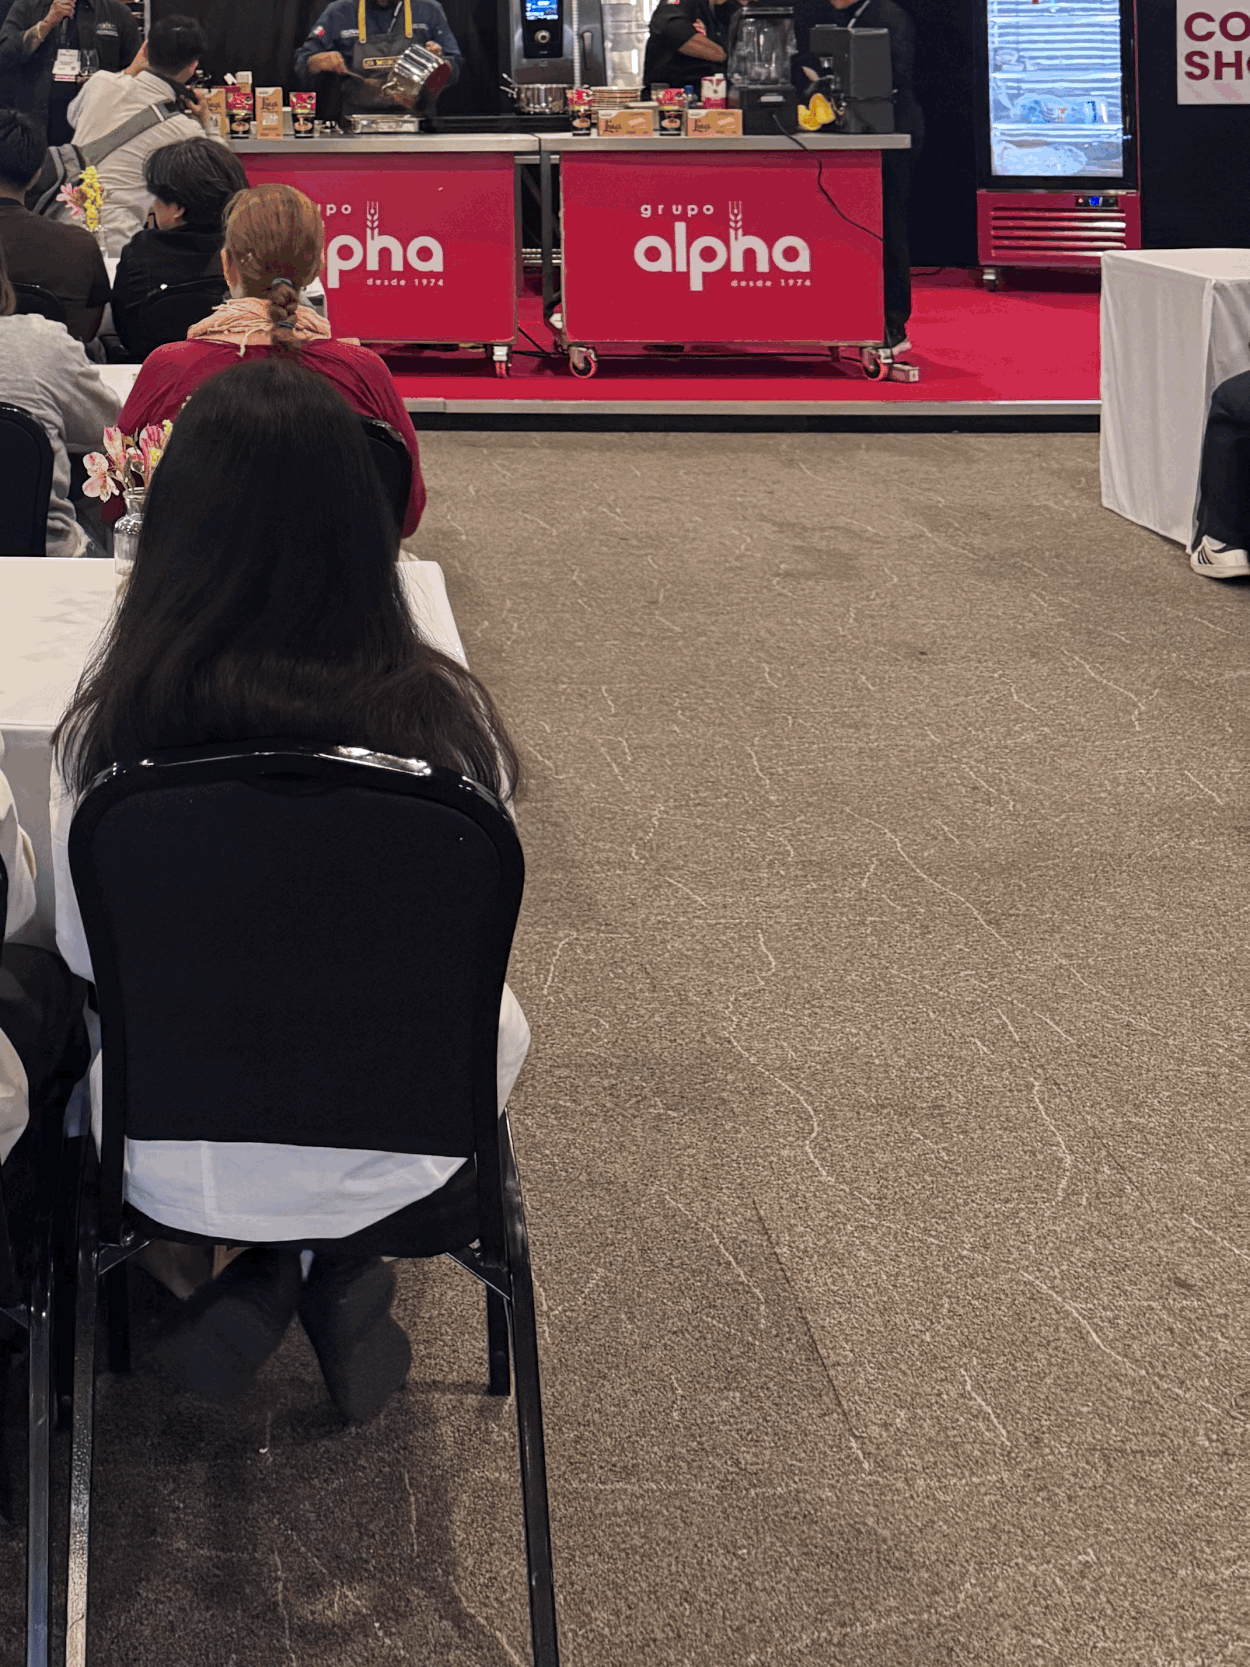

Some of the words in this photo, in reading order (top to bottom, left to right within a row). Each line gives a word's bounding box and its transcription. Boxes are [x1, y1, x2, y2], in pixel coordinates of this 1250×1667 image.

[1184, 50, 1250, 81] SH
[640, 204, 714, 218] grupo
[326, 201, 444, 289] pha
[634, 201, 811, 291] alpha
[366, 277, 406, 286] desde
[730, 278, 772, 287] desde
